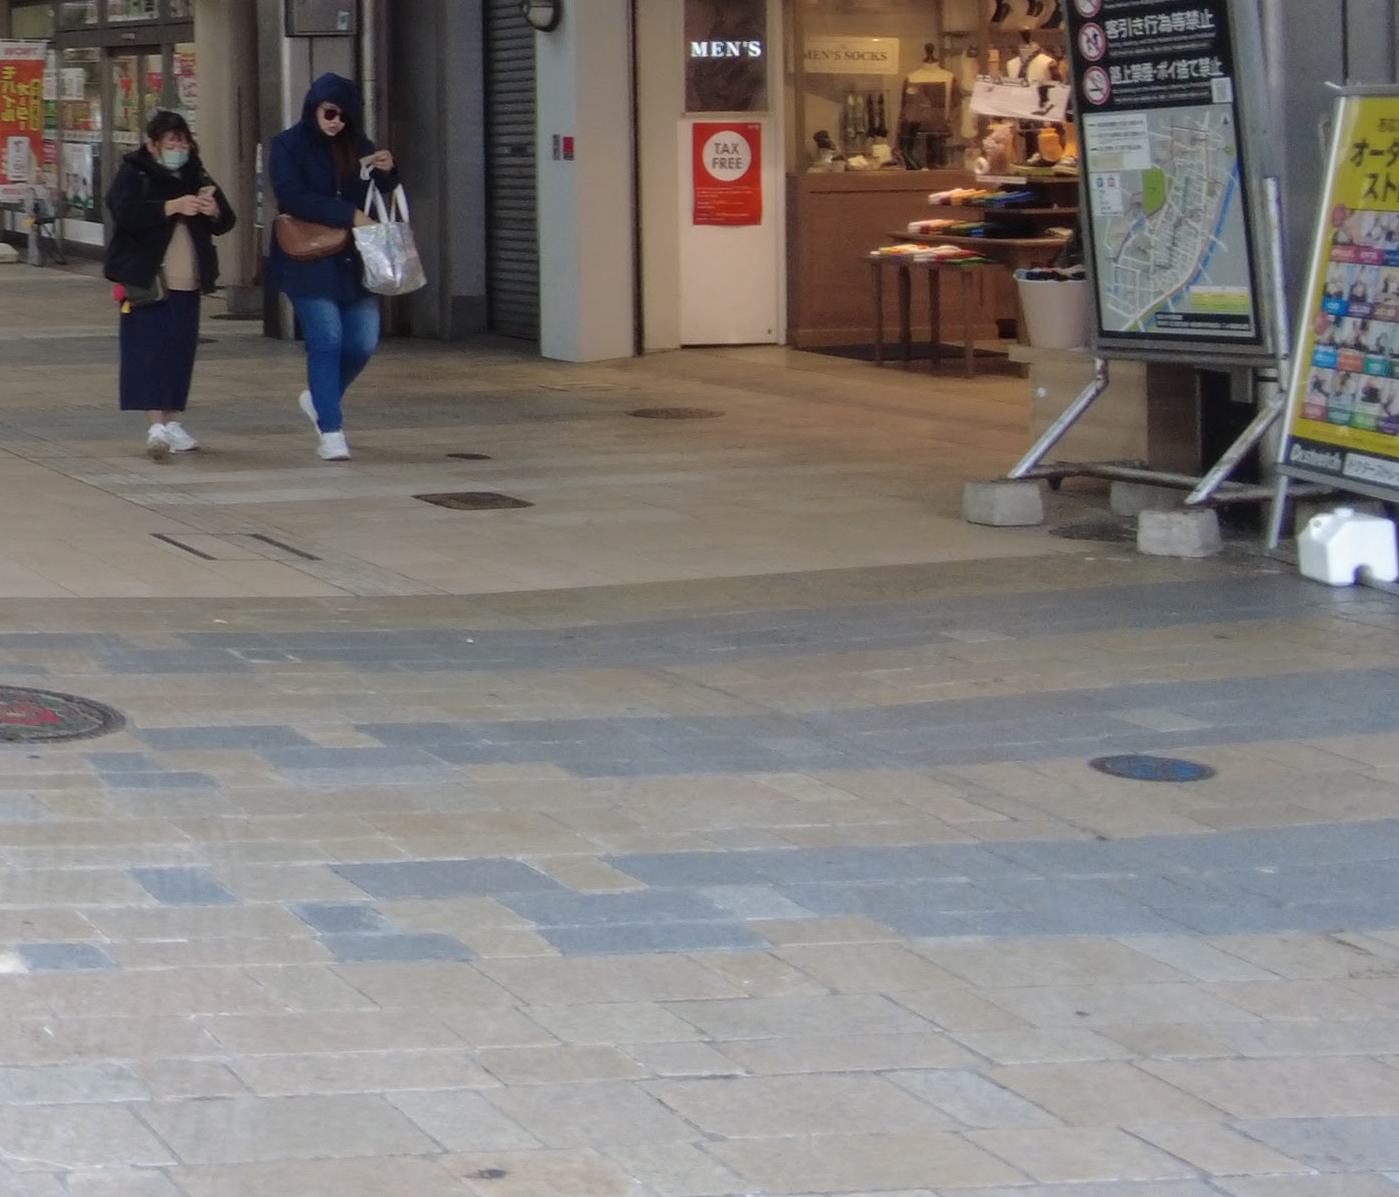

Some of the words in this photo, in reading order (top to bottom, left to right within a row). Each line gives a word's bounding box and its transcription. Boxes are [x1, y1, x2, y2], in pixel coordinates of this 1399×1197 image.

[1105, 8, 1216, 40] 客引き行為等禁止
[690, 40, 762, 59] MEN'S
[844, 49, 888, 63] SOCKS
[713, 141, 741, 156] TAX
[711, 156, 743, 171] FREE
